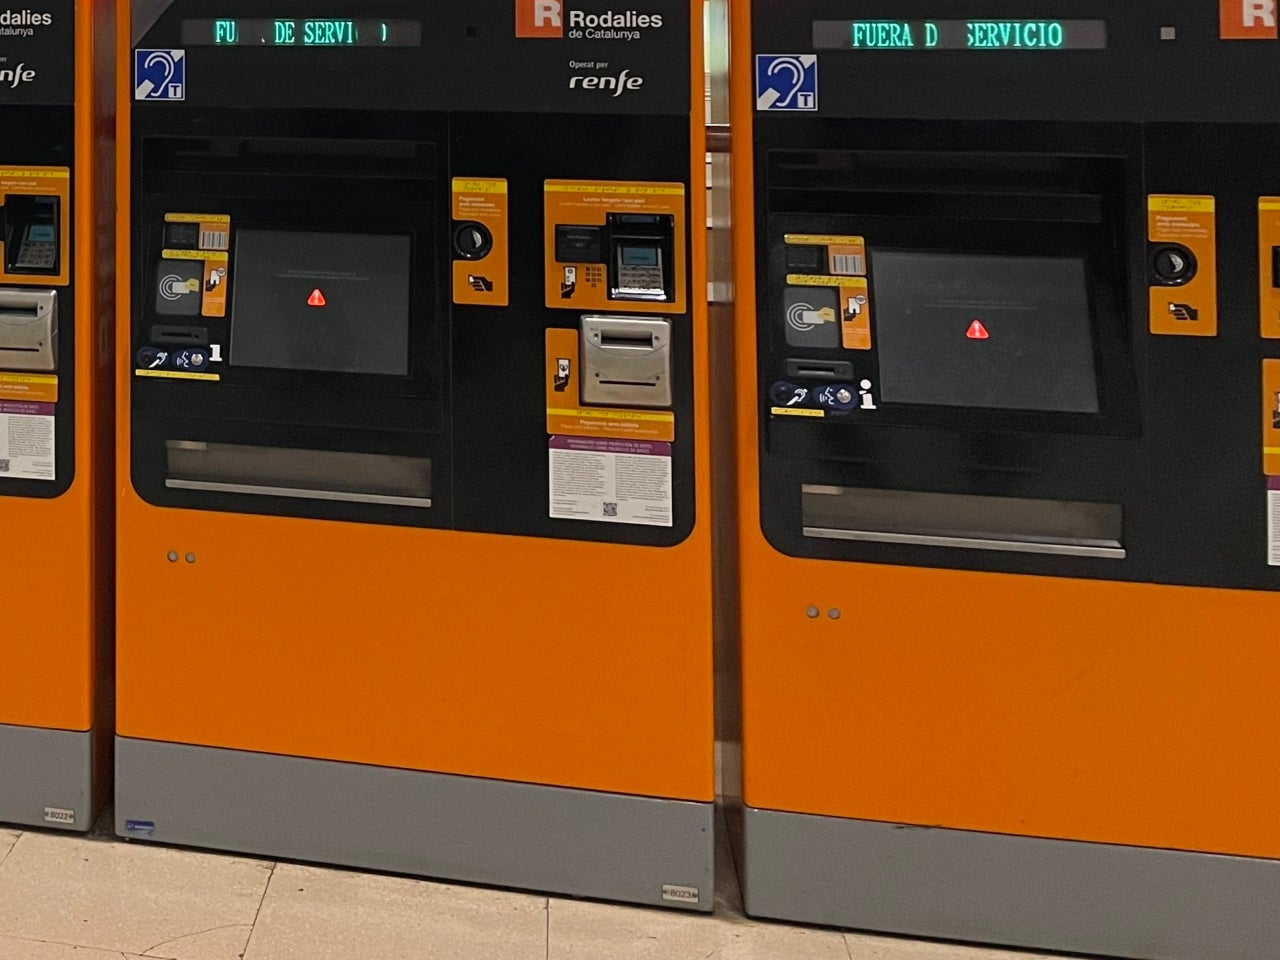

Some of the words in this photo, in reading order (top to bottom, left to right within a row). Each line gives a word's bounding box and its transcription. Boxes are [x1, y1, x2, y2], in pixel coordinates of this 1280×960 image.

[534, 0, 561, 27] R
[570, 10, 663, 27] Rodalies
[569, 29, 583, 39] de
[585, 28, 641, 41] Catalunya
[852, 22, 914, 47] FUERA
[569, 60, 594, 69] Operat
[596, 62, 609, 70] per
[569, 69, 643, 97] renfe
